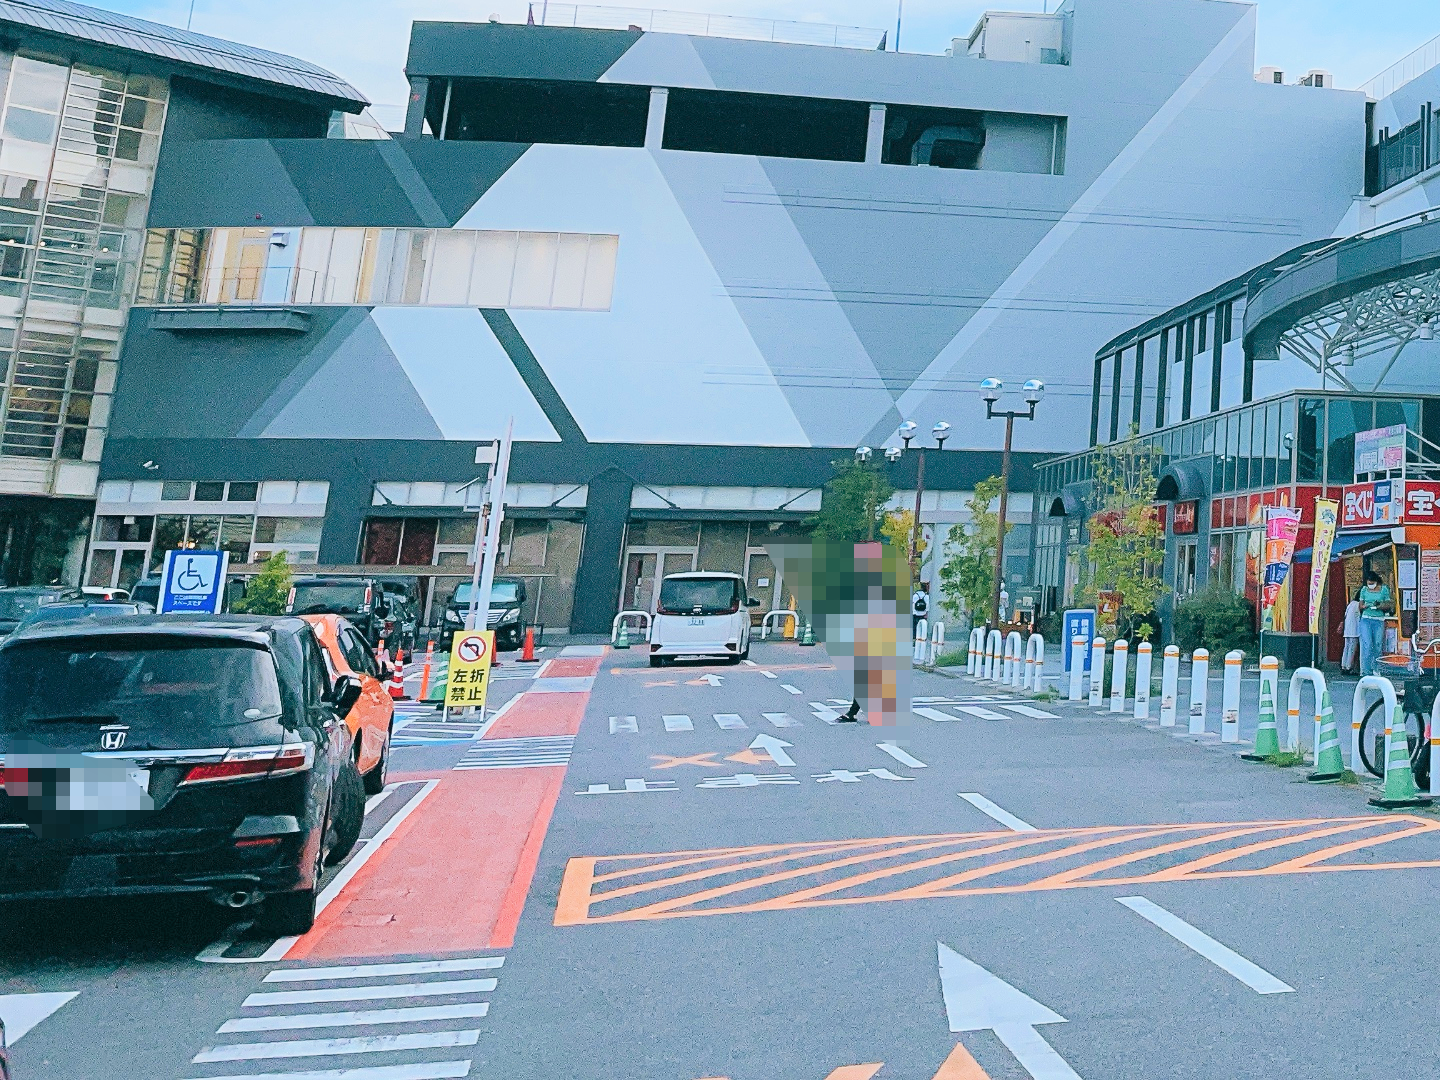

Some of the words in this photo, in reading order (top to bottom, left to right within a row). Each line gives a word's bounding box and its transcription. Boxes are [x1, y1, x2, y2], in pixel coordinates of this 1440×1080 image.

[1345, 490, 1373, 521] 宝くじ
[452, 668, 485, 683] 左折
[450, 686, 482, 701] 禁止
[574, 767, 916, 796] 止まれ
